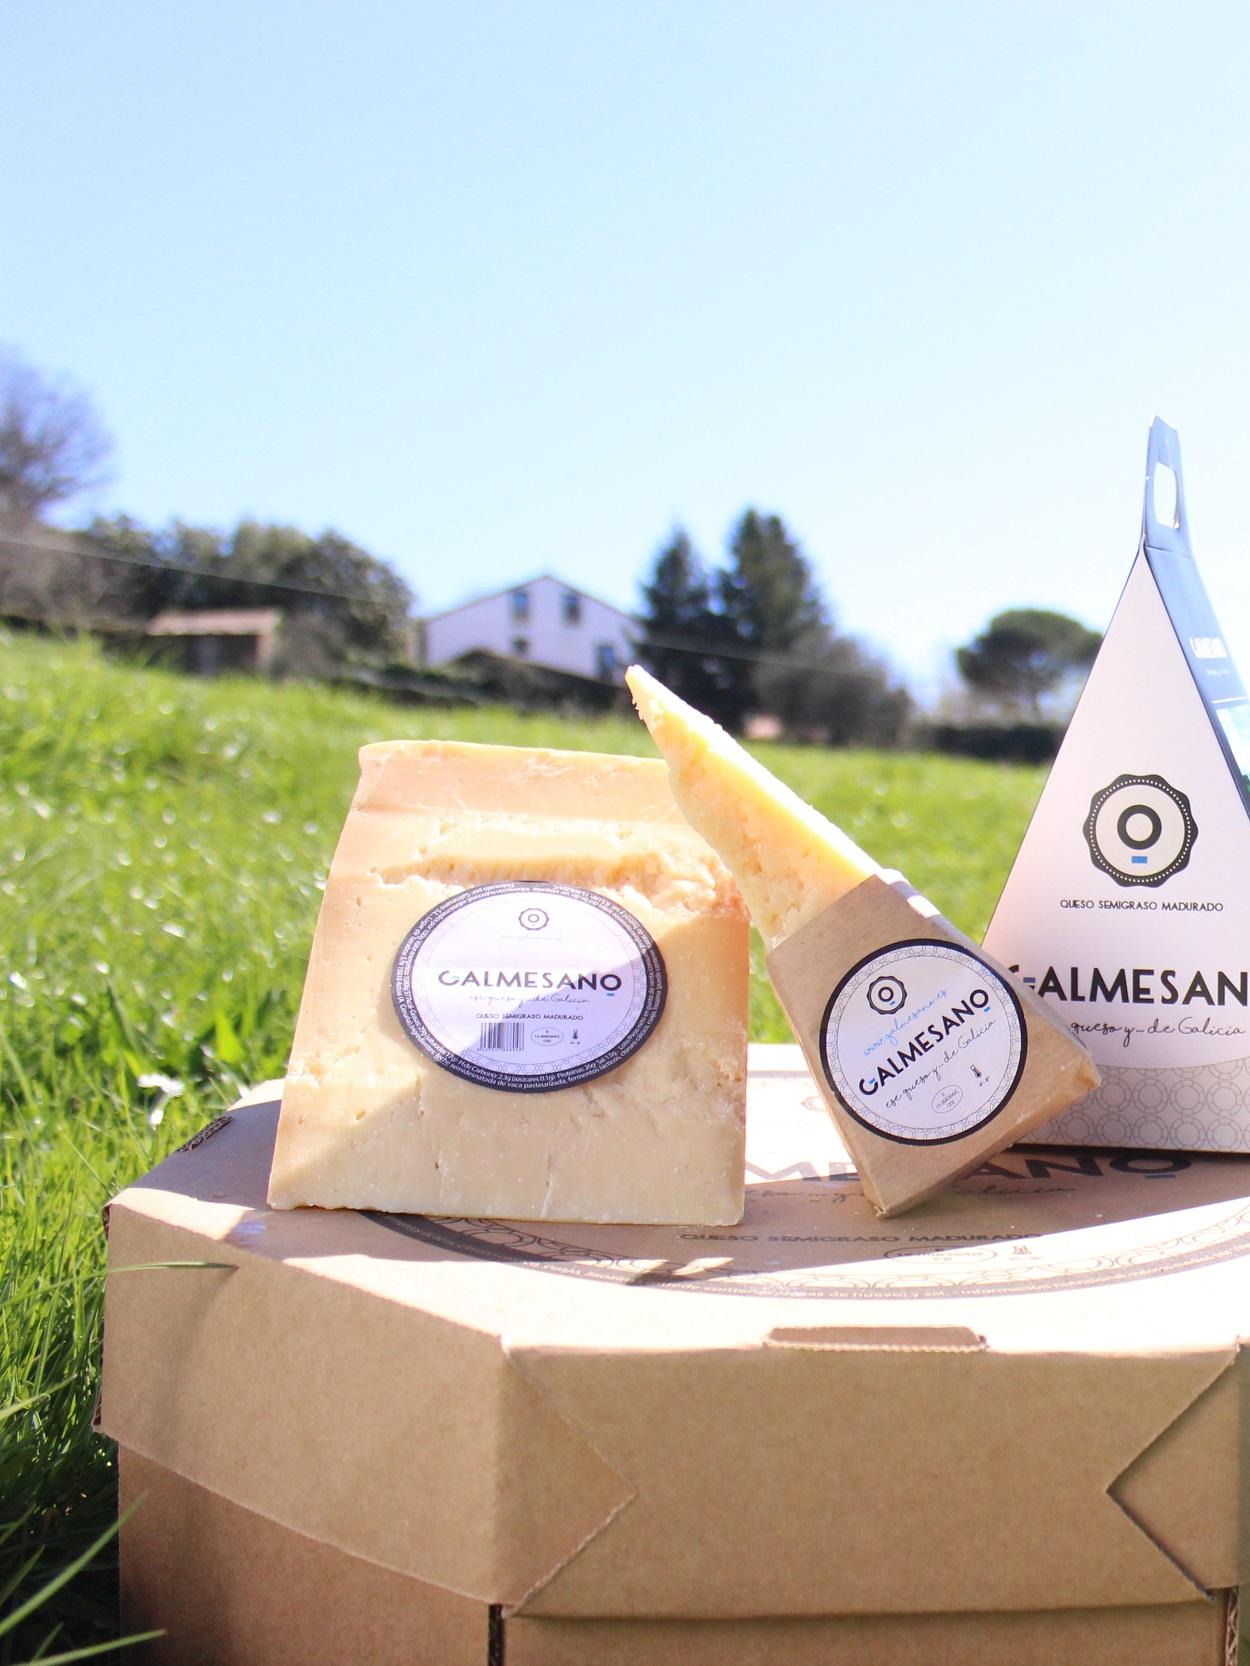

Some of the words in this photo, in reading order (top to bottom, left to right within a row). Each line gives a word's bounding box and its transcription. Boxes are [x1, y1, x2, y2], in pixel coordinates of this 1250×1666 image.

[1060, 899, 1095, 909] QUESO
[1098, 900, 1158, 910] SEMIGRASO
[1161, 901, 1224, 912] MADURADO
[438, 970, 622, 992] GALMESANO
[958, 1020, 996, 1049] Galicia
[1148, 1019, 1175, 1034] de
[1178, 1016, 1246, 1036] Galicia
[859, 989, 989, 1095] GALMESANO
[908, 1233, 1042, 1242] MADURADO
